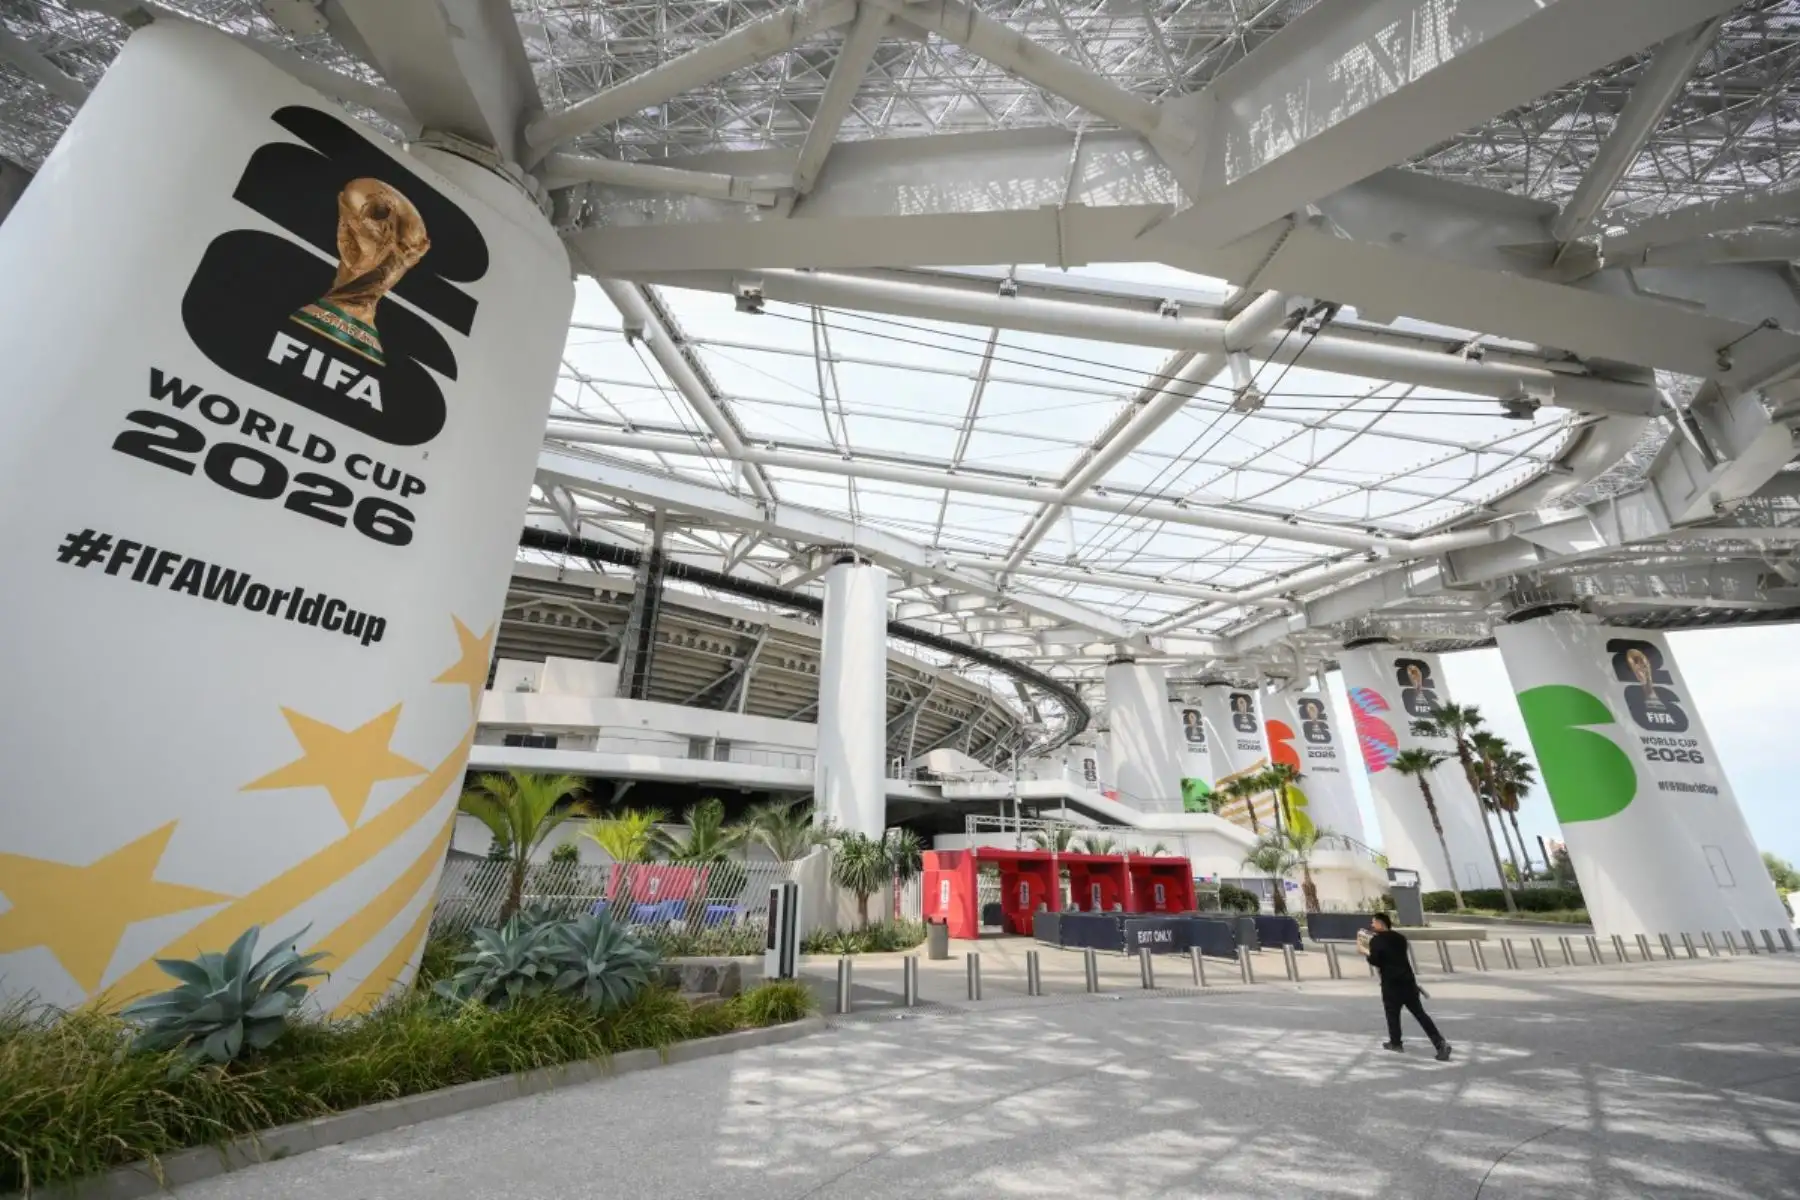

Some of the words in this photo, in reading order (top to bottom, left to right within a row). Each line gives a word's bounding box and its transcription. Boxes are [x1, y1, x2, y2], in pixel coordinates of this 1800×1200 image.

[267, 331, 383, 413] FIFA
[151, 366, 337, 465] WORLD
[344, 453, 427, 498] CUP
[112, 410, 416, 546] 2026
[57, 528, 387, 647] #FIFAWorldCup
[1640, 736, 1677, 747] WORLD
[1678, 738, 1698, 748] CUP
[1646, 711, 1675, 725] FIFA
[1644, 747, 1704, 764] 2026
[1153, 929, 1172, 943] ONLY
